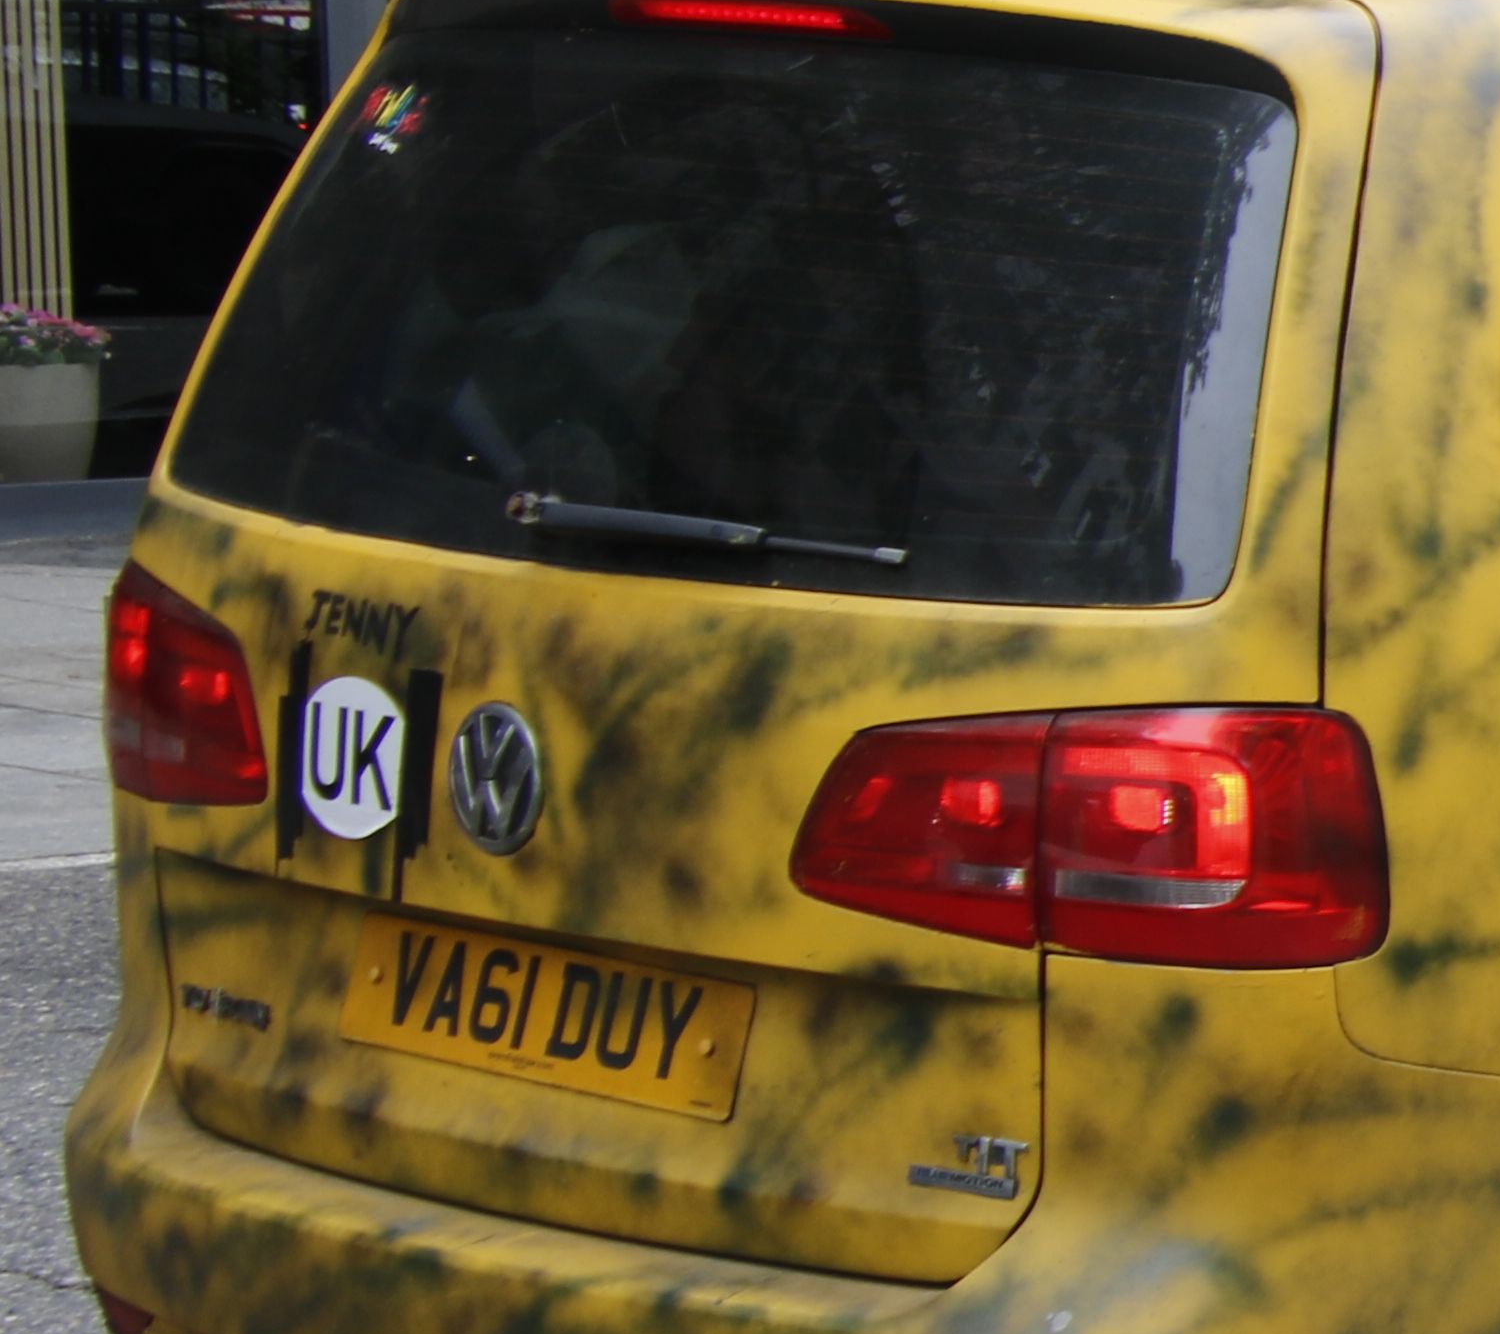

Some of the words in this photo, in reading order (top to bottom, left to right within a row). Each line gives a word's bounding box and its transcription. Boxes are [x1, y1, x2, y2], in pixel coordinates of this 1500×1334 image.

[303, 589, 421, 661] JENNY
[310, 700, 397, 813] UK
[544, 961, 704, 1080] DUY
